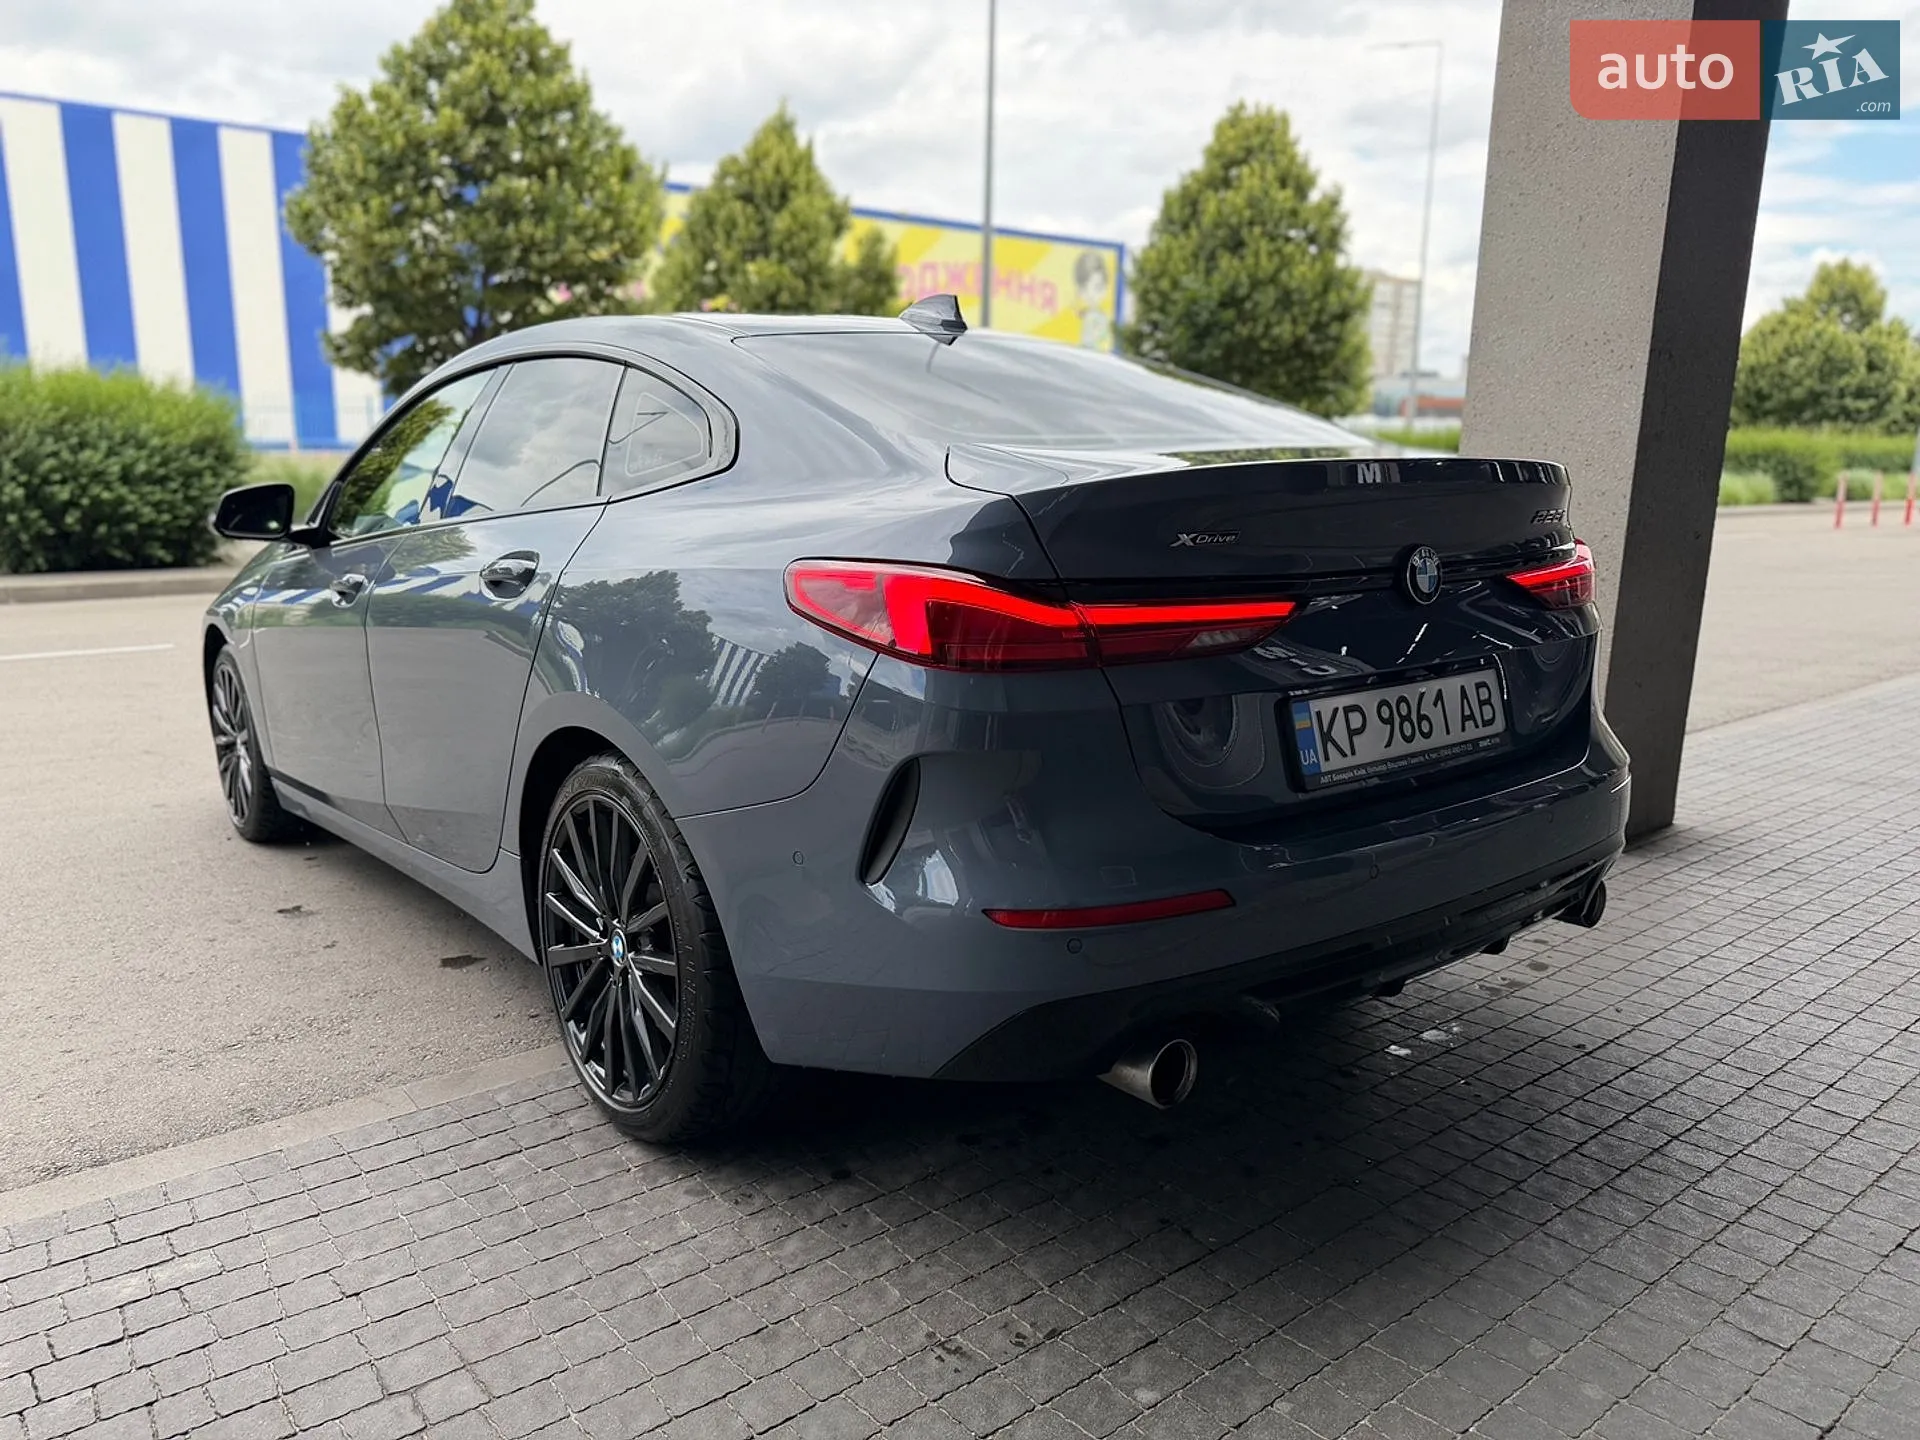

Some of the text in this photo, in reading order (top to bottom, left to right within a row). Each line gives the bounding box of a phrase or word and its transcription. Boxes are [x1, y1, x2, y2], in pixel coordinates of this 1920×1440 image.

[1316, 704, 1367, 761] KP
[1376, 686, 1450, 749] 9861
[1460, 680, 1496, 733] AB
[1300, 748, 1319, 765] UA
